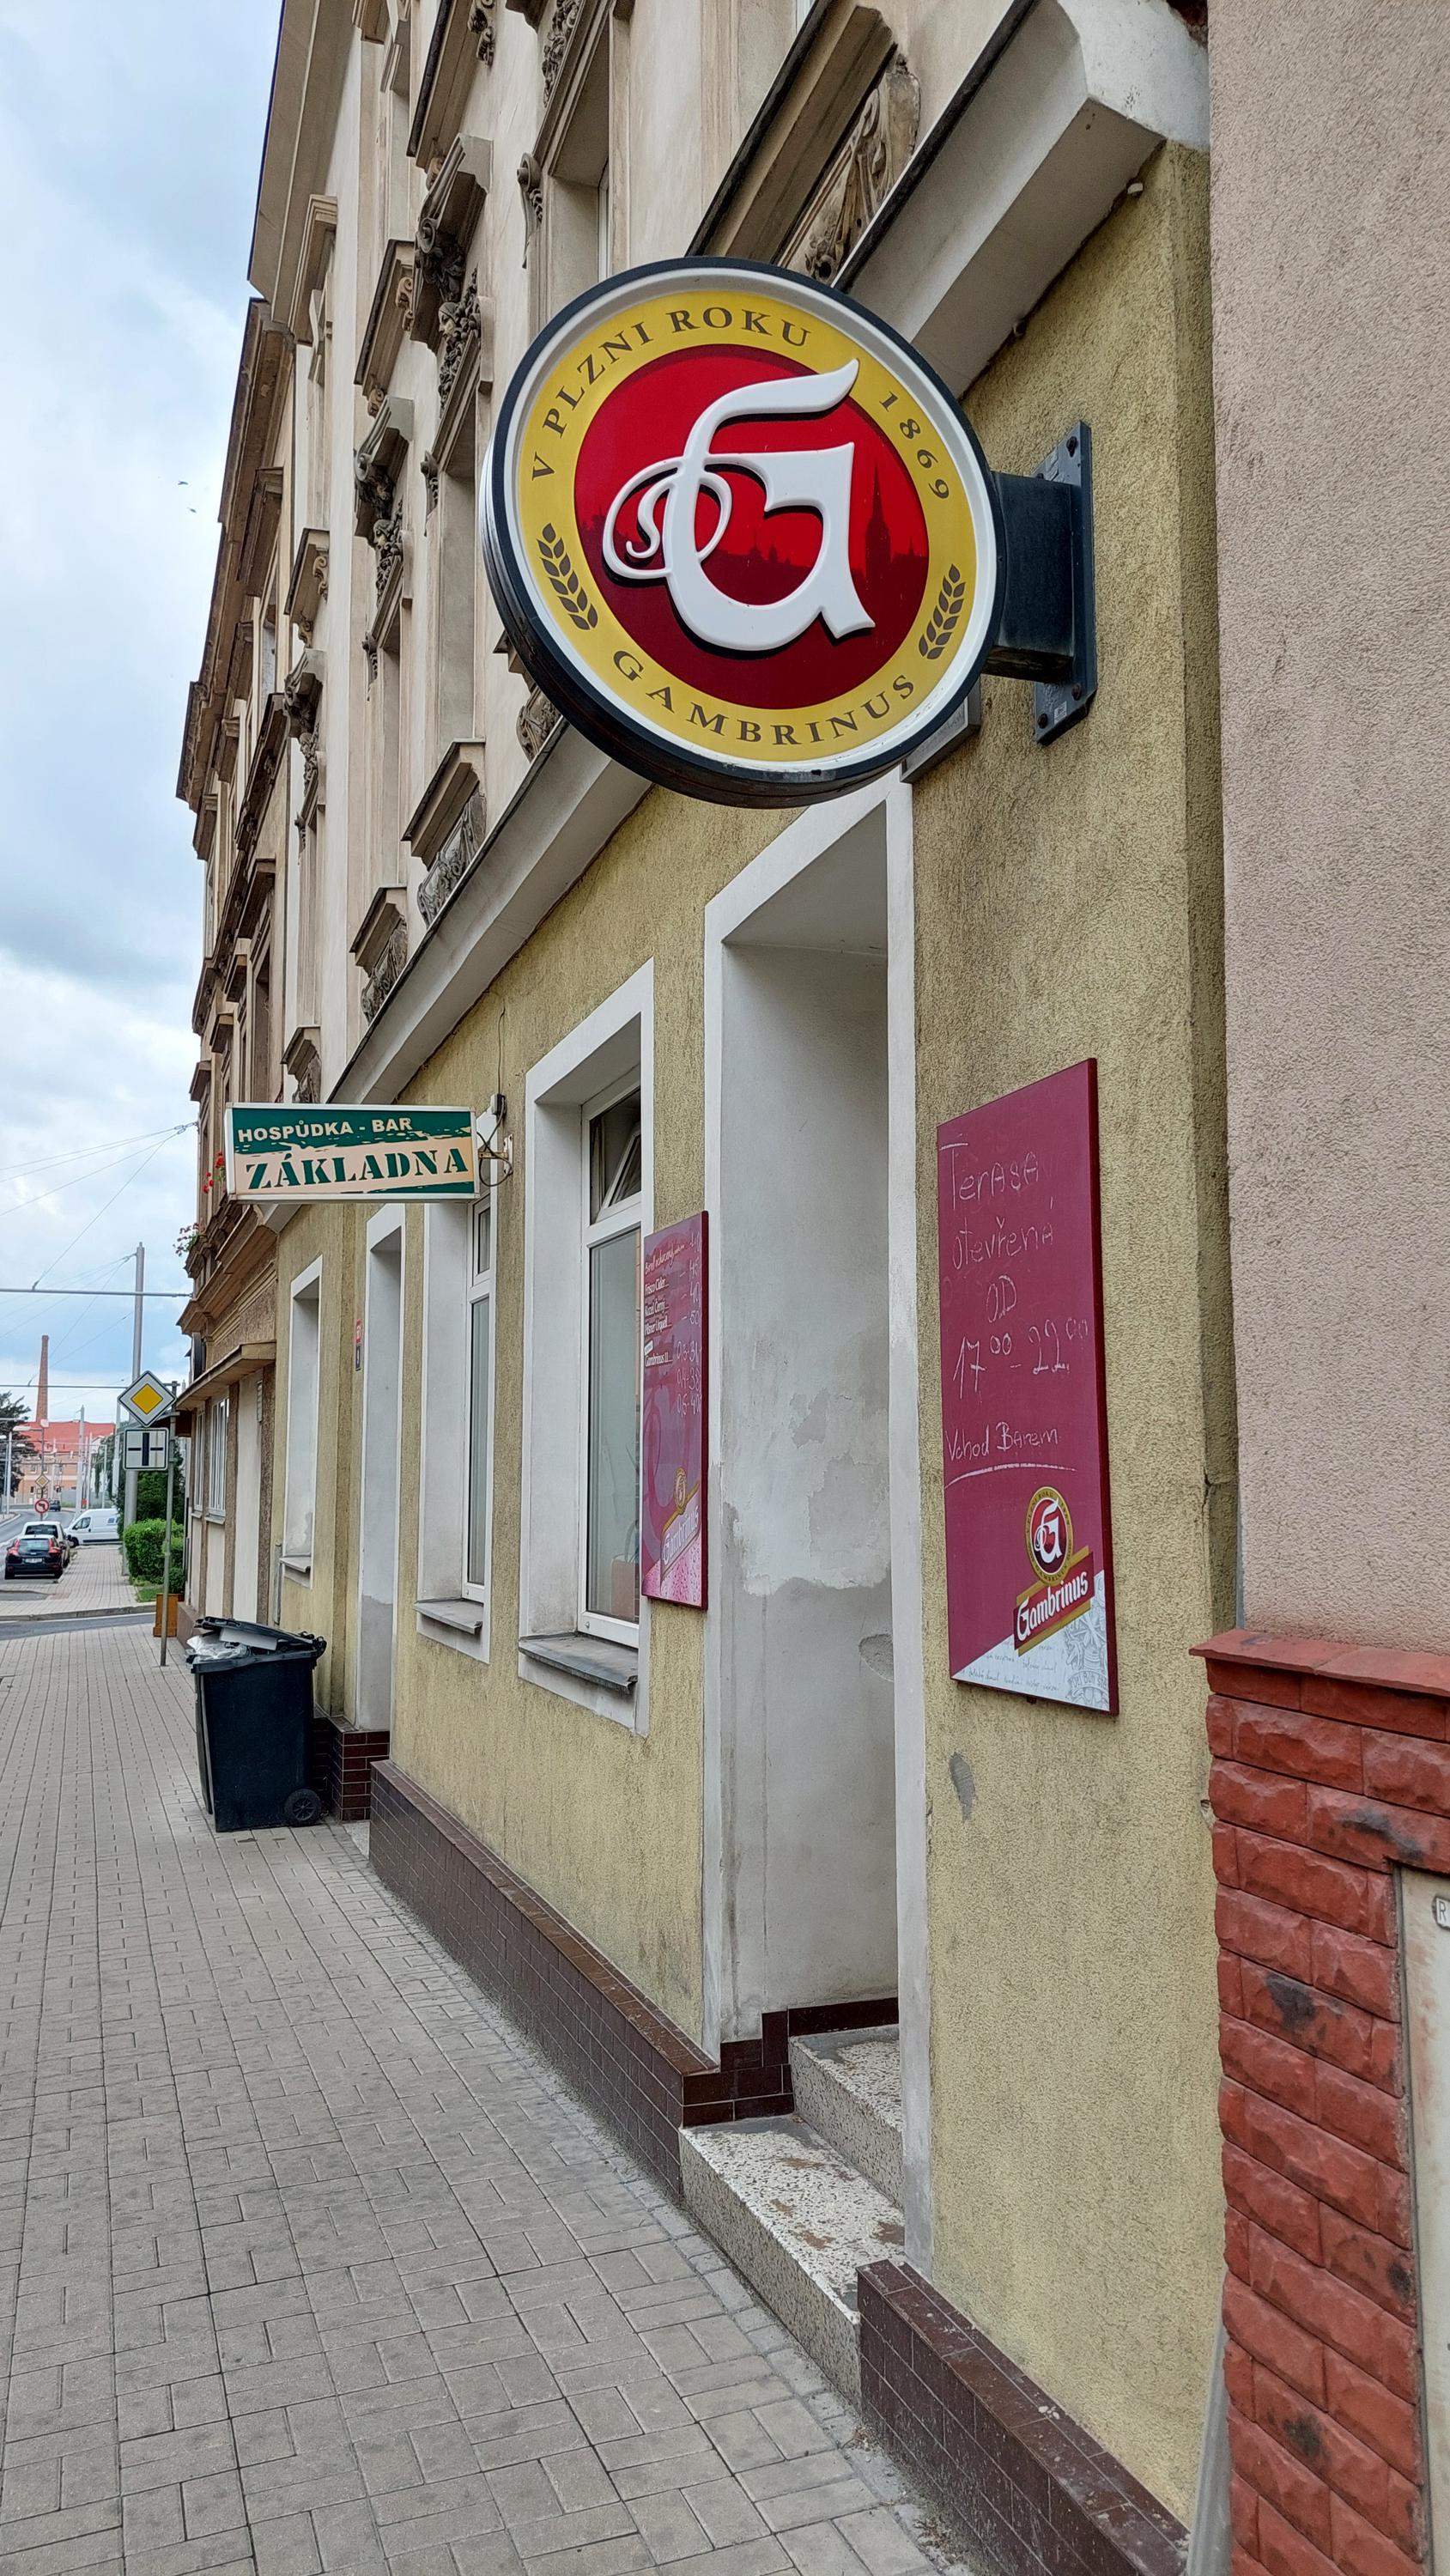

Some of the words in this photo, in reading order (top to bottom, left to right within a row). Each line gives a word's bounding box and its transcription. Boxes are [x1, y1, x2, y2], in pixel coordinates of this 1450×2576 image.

[666, 306, 812, 349] ROKU
[542, 322, 654, 439] PLZNI
[532, 459, 556, 481] V
[879, 390, 951, 501] 1869
[612, 650, 917, 745] GAMBRINUS
[238, 1120, 354, 1143] HOSPŮDKA
[372, 1118, 413, 1133] BAR
[246, 1148, 469, 1190] ZÁKLADNA
[1016, 1571, 1089, 1642] Gambrinus
